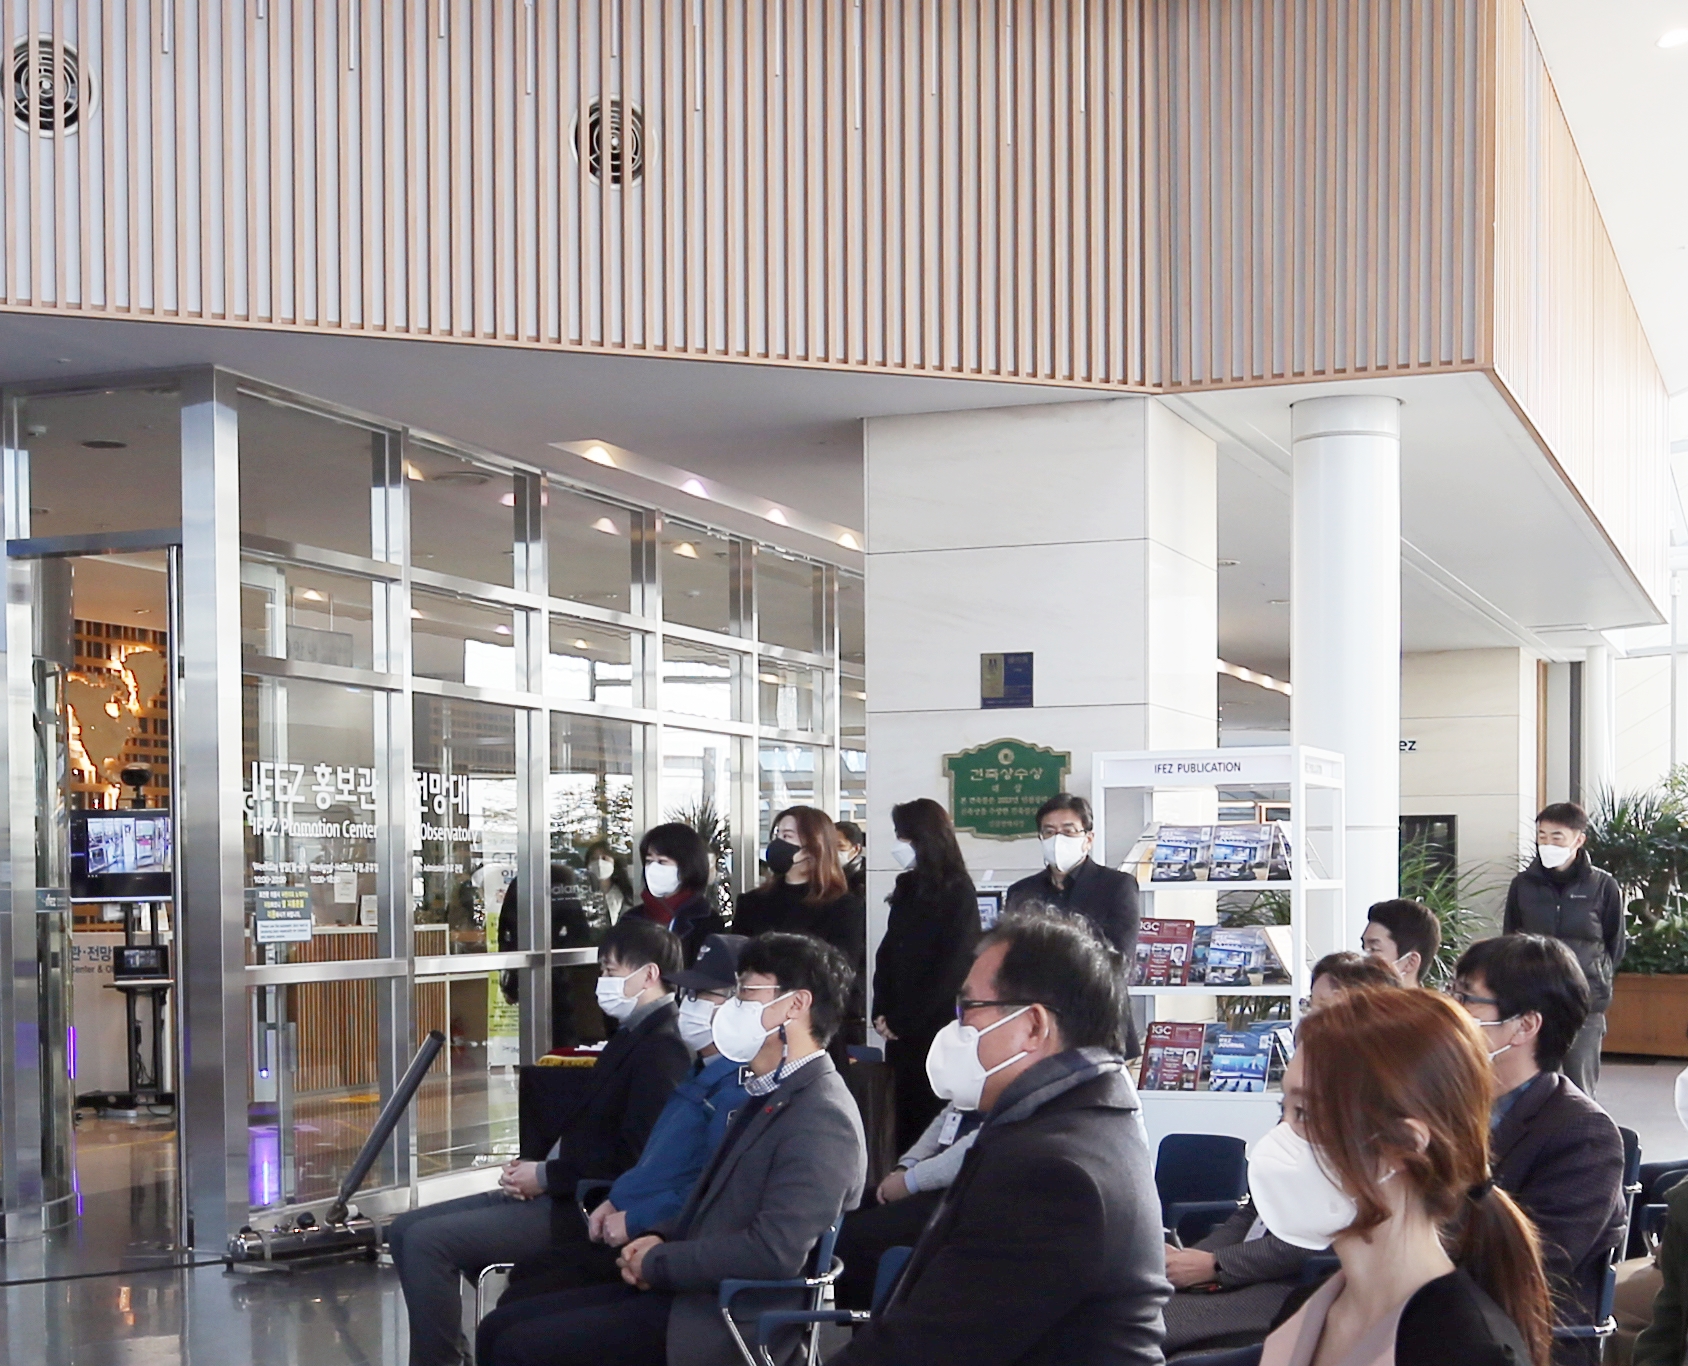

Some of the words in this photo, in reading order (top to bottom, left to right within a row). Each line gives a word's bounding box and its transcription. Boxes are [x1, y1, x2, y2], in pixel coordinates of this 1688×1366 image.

[970, 767, 1043, 781] 건축상수상
[1154, 763, 1174, 774] IFEZ
[1177, 761, 1241, 774] PUBLICATION
[252, 762, 305, 803] IFEZ
[311, 763, 378, 811] 홍보관
[252, 817, 278, 837] IFEZ
[280, 818, 340, 838] Promotion
[342, 820, 377, 839] Center
[420, 823, 478, 844] Observatory
[1151, 1025, 1172, 1035] IGC
